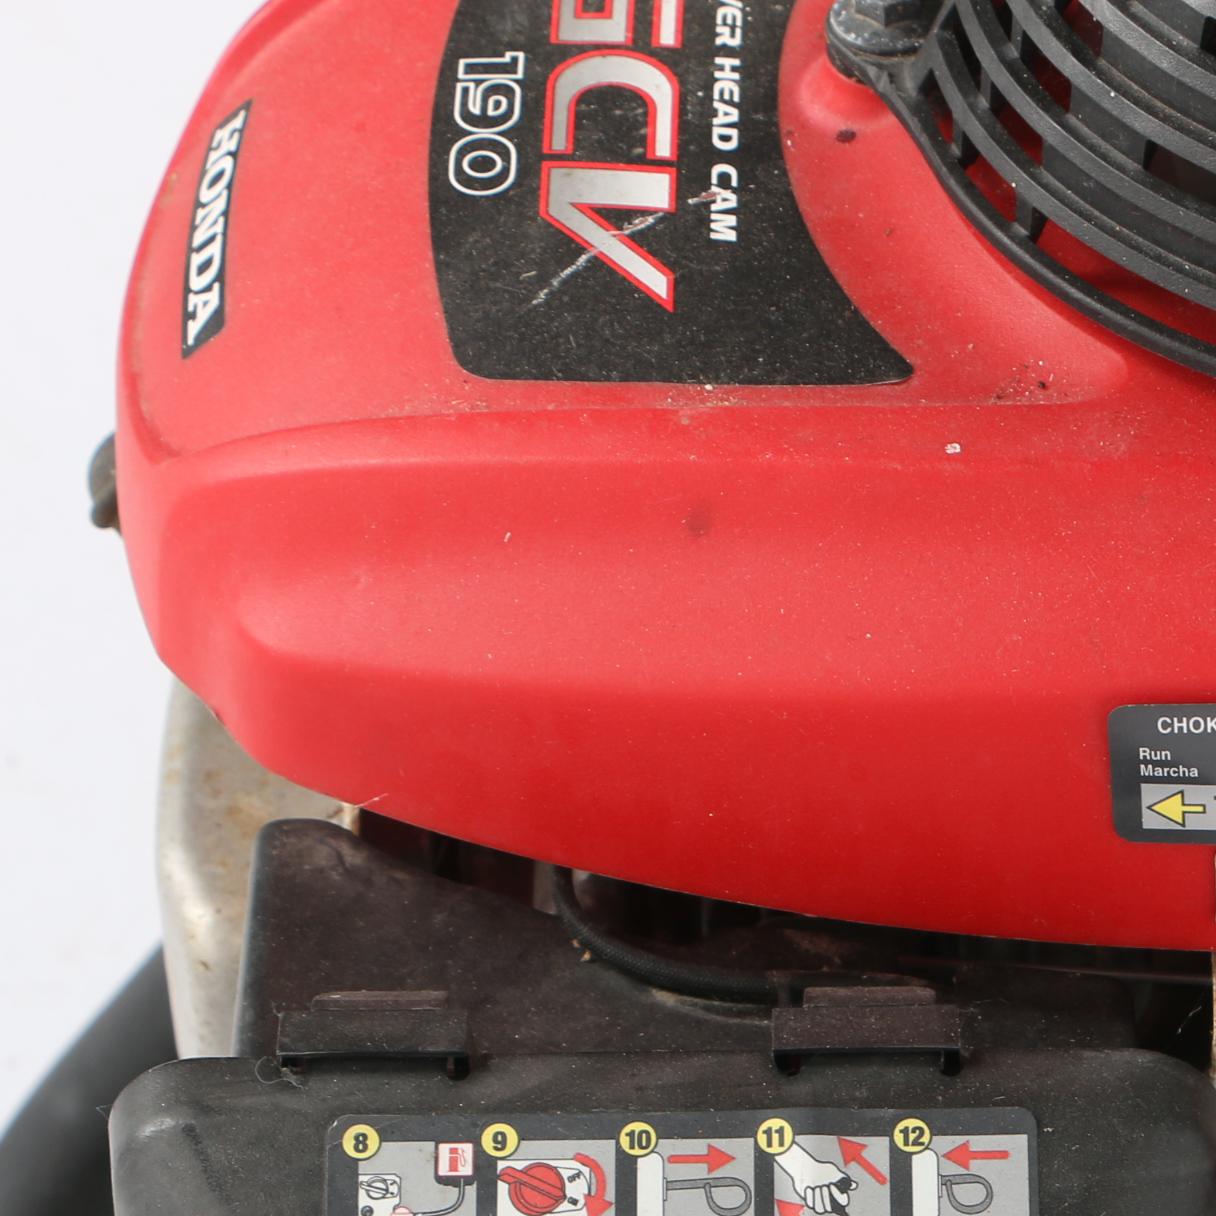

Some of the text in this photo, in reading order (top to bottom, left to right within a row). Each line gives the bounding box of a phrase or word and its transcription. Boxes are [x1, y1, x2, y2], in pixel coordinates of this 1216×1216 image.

[711, 55, 741, 152] HEAD
[448, 51, 525, 197] 190
[709, 163, 739, 243] CAM
[186, 111, 248, 345] HONDA
[1139, 748, 1170, 760] Run
[1140, 764, 1198, 777] Marcha
[353, 1133, 368, 1153] 8
[492, 1131, 507, 1151] 9
[624, 1128, 653, 1151] 10
[762, 1126, 787, 1148] 11
[899, 1125, 926, 1147] 12
